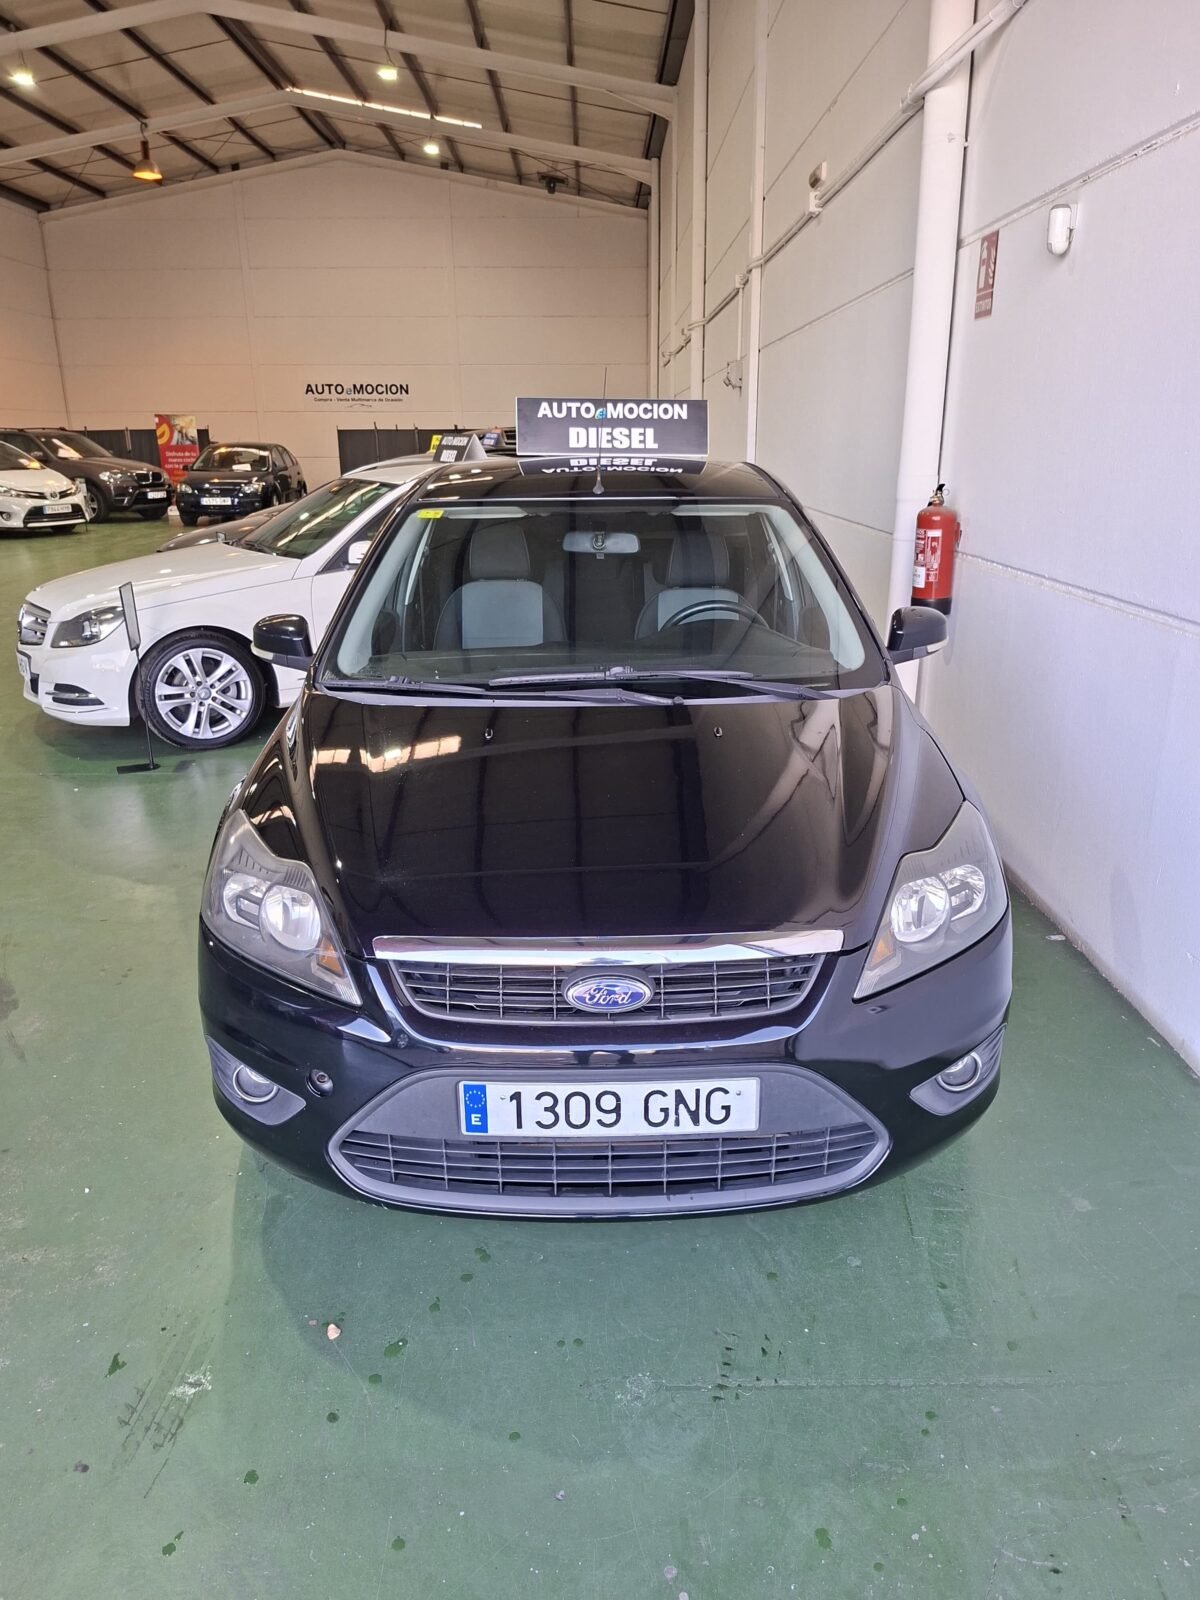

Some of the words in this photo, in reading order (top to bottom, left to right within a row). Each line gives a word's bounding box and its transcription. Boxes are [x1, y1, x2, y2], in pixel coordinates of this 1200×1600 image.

[568, 427, 658, 449] DIESEL
[584, 982, 632, 1005] Ford
[471, 1113, 482, 1126] E
[509, 1090, 622, 1129] 1309
[643, 1086, 732, 1128] GNG
